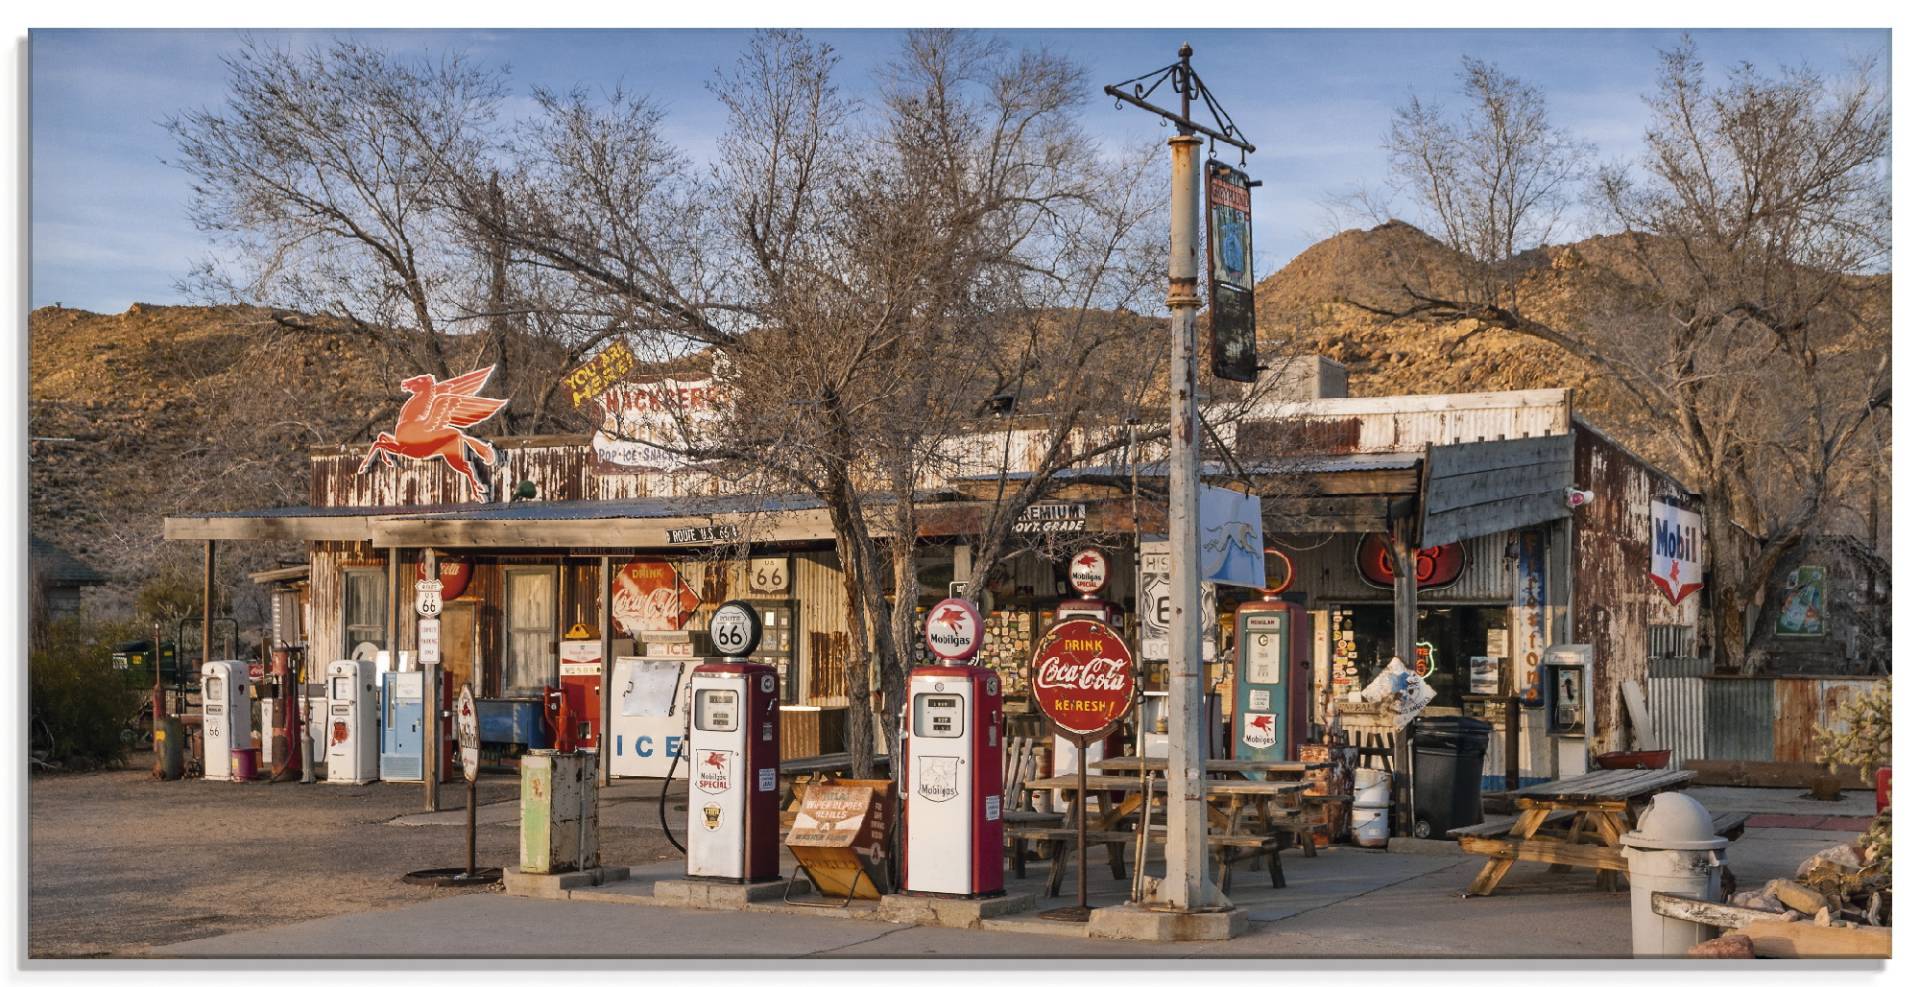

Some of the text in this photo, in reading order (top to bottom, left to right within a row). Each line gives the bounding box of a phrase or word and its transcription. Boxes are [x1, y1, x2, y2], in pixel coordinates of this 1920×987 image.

[565, 363, 597, 390] YOU
[1016, 505, 1080, 521] REMIUM
[1042, 520, 1085, 532] GRADE
[673, 529, 697, 543] ROUTE
[1655, 517, 1697, 563] Mobil
[632, 568, 664, 579] DRINK
[756, 567, 783, 586] 66
[1072, 572, 1102, 582] Mobilgas
[1076, 580, 1098, 588] SPECIAL
[422, 599, 436, 613] 66
[613, 587, 685, 618] Coca-Cola
[719, 625, 742, 645] 66
[930, 634, 970, 647] Mobilgas
[666, 644, 690, 655] ICE
[1065, 639, 1104, 652] DRINK
[1037, 656, 1129, 691] Coca-Cola
[616, 735, 681, 757] ICE
[1245, 735, 1275, 744] Mobilgas
[701, 772, 727, 781] Mobilgas
[699, 780, 727, 789] SPECIAL
[921, 784, 955, 797] Mobilgas
